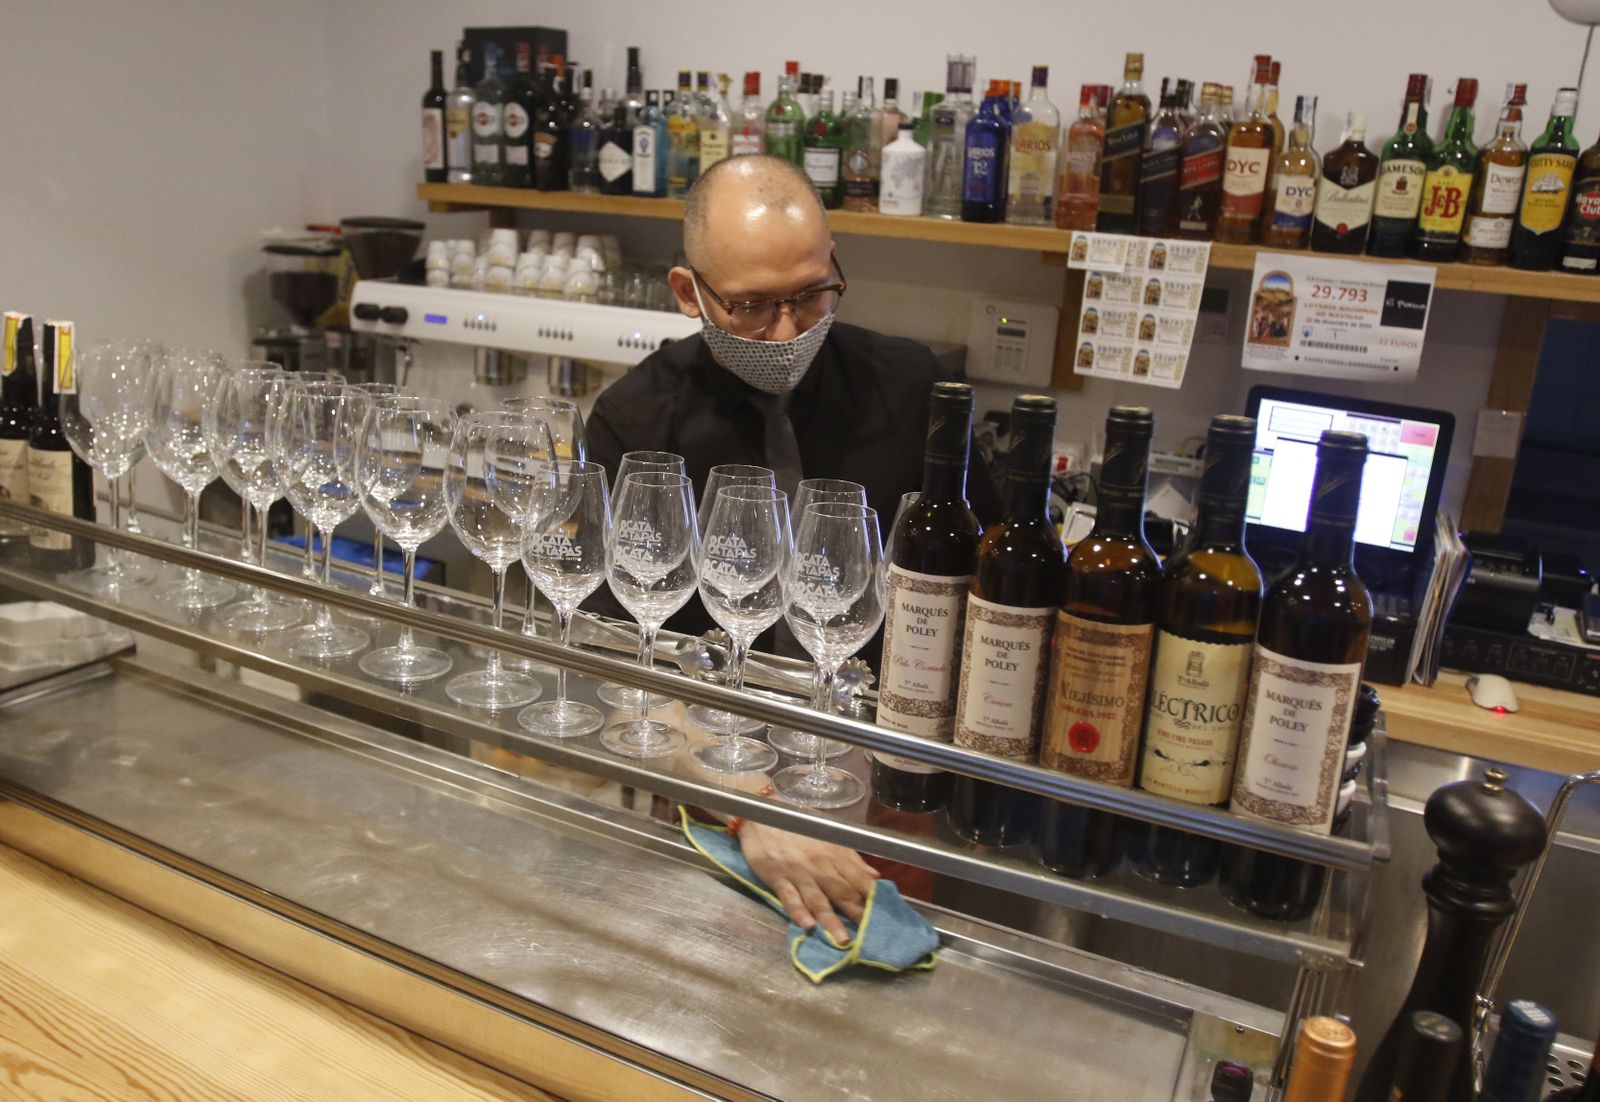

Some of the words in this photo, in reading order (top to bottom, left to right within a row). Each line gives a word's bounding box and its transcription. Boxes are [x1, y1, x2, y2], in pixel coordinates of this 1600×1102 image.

[1016, 139, 1051, 153] LARIOS
[1226, 159, 1261, 174] DYC
[1285, 185, 1314, 197] DYC
[1424, 185, 1462, 219] J&B
[1311, 284, 1369, 303] 29.793
[628, 520, 653, 533] CATA
[541, 534, 572, 546] CATA
[629, 530, 662, 543] TAPAS
[717, 535, 748, 549] CATA
[544, 545, 583, 558] TAPAS
[721, 547, 757, 559] TAPAS
[901, 602, 949, 618] MARQUÉS
[916, 617, 928, 626] DE
[906, 624, 939, 638] POLEY
[980, 635, 1031, 651] MARQUÉS
[996, 651, 1009, 660] DE
[984, 658, 1020, 672] POLEY
[1266, 689, 1323, 711] MARQUÉS
[1283, 708, 1298, 718] DE
[1269, 715, 1309, 732] POLEY
